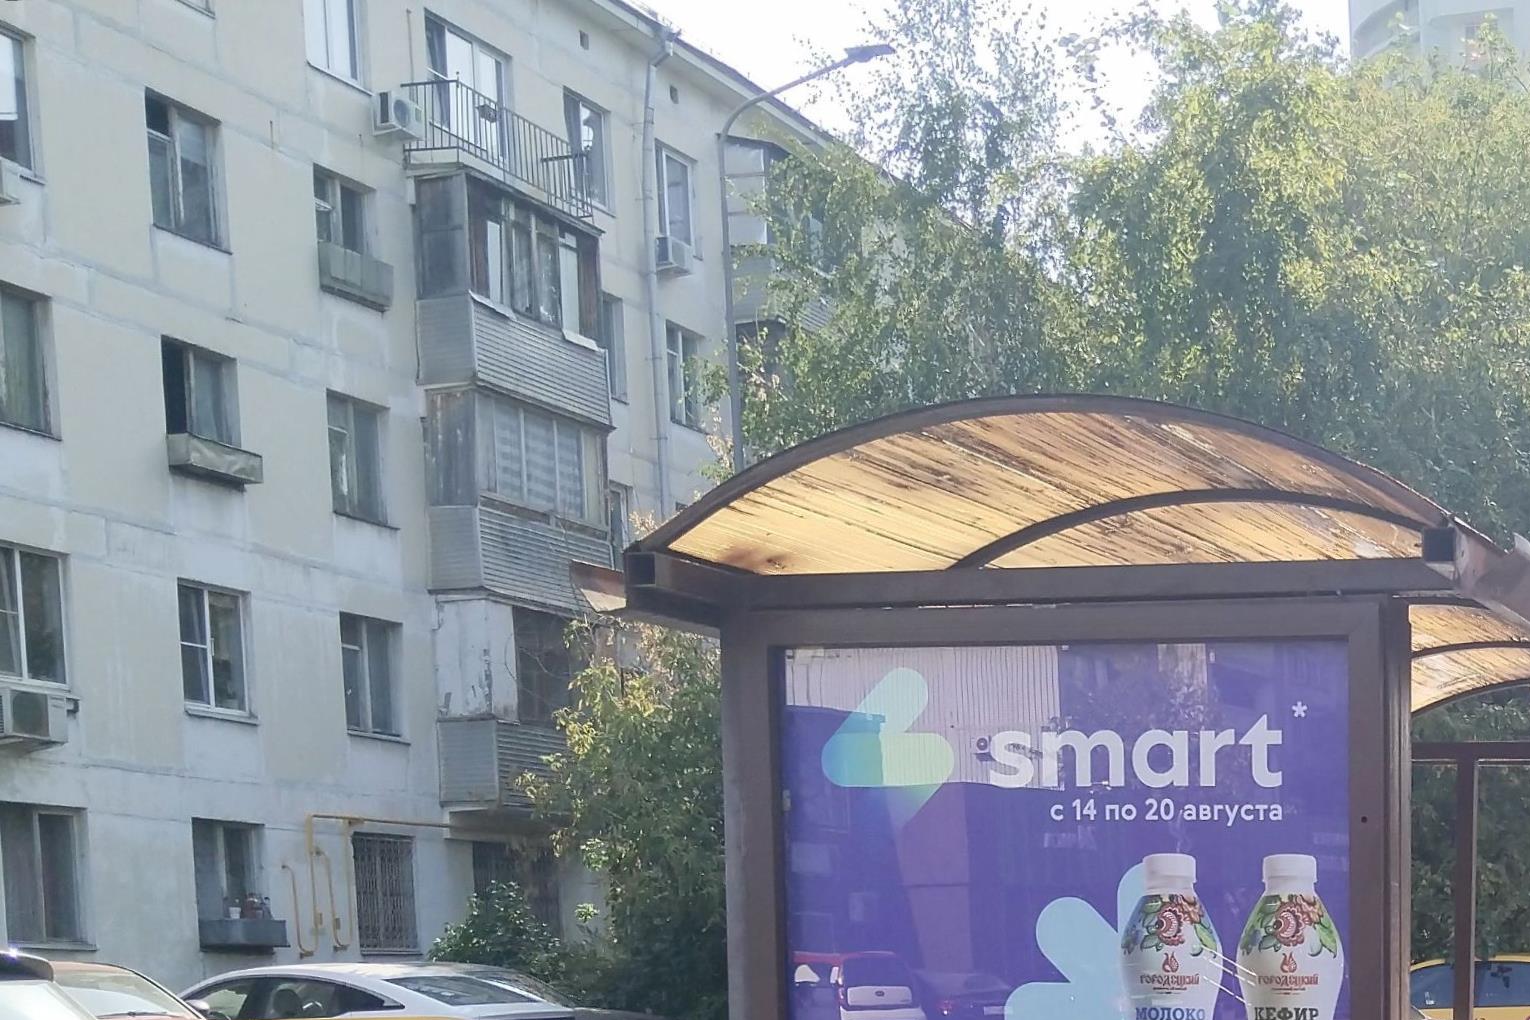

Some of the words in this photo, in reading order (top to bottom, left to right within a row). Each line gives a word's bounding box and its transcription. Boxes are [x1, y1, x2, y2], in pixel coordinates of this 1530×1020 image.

[989, 713, 1283, 788] smart
[1050, 804, 1064, 821] с
[1072, 799, 1096, 820] 14
[1105, 804, 1137, 821] по
[1145, 798, 1174, 821] 20
[1183, 803, 1282, 826] августа
[1136, 1008, 1205, 1020] МОЛОКО
